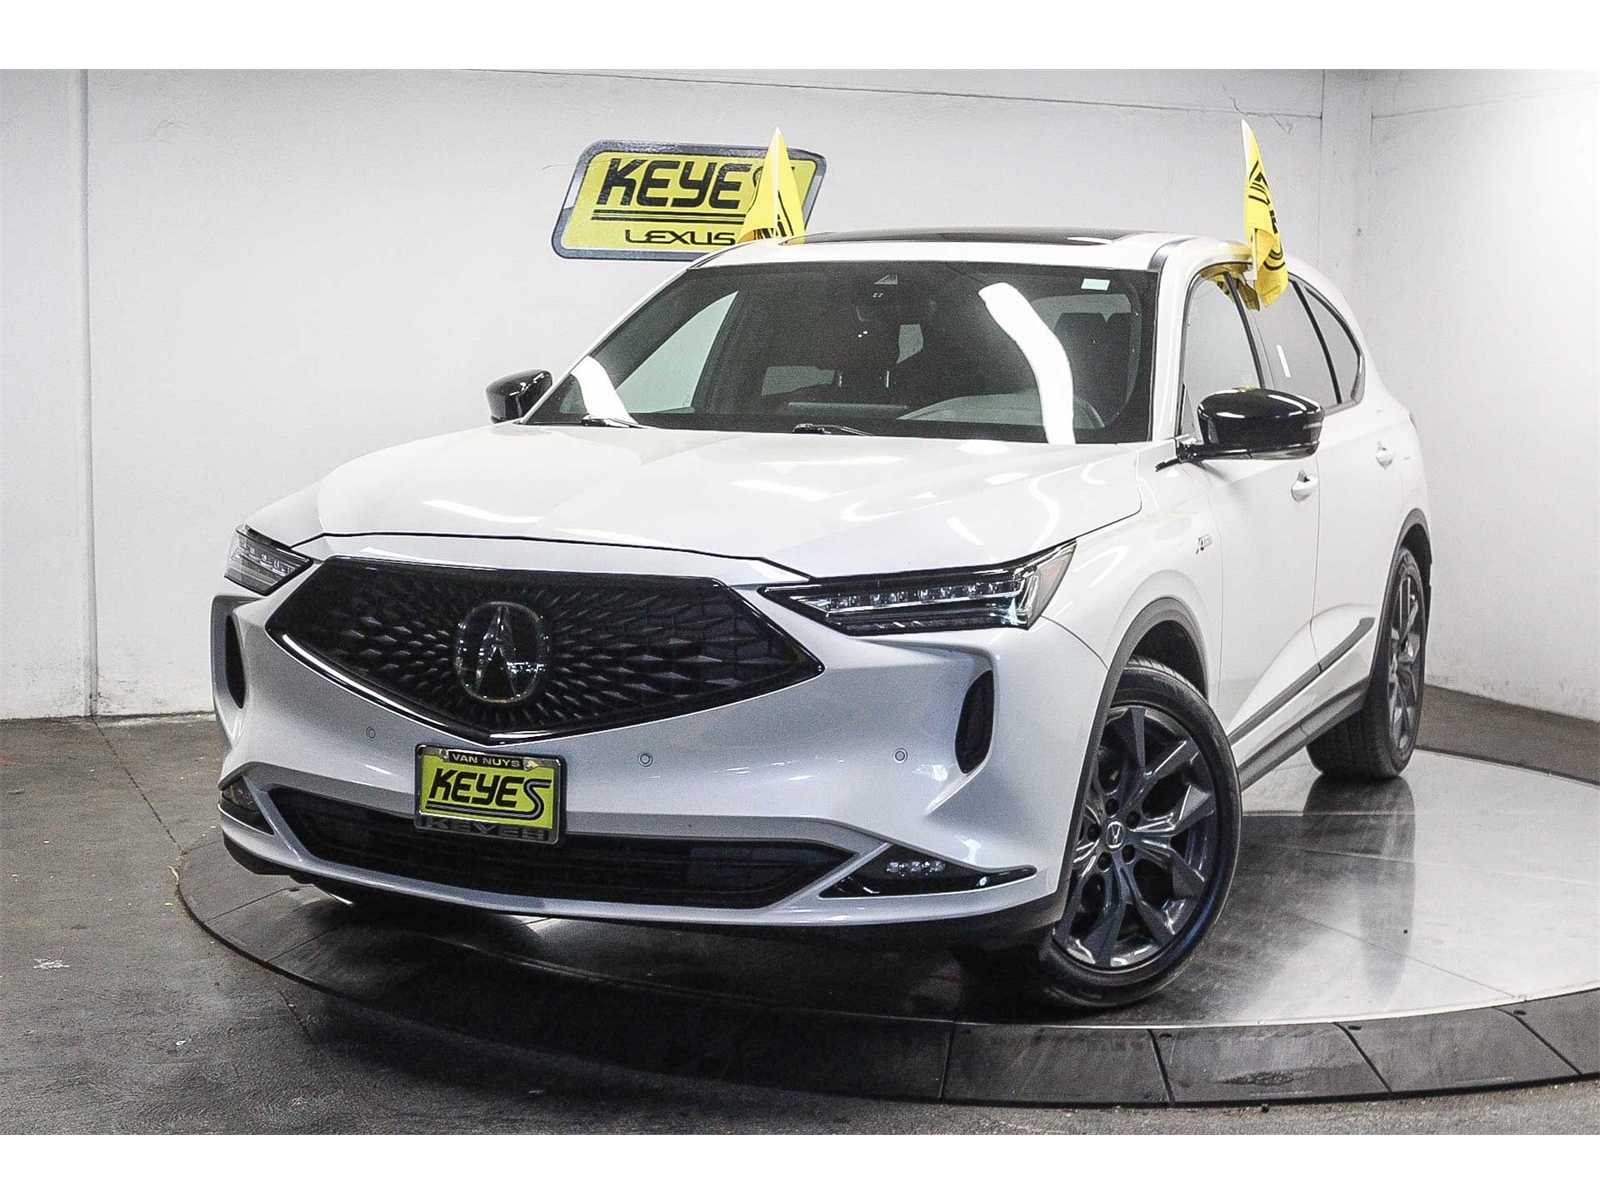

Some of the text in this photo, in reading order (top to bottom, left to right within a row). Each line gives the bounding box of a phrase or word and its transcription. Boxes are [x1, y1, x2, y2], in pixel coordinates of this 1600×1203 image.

[625, 228, 736, 246] LEXUS
[451, 753, 520, 767] VAN NUYS
[429, 767, 553, 821] KEYES
